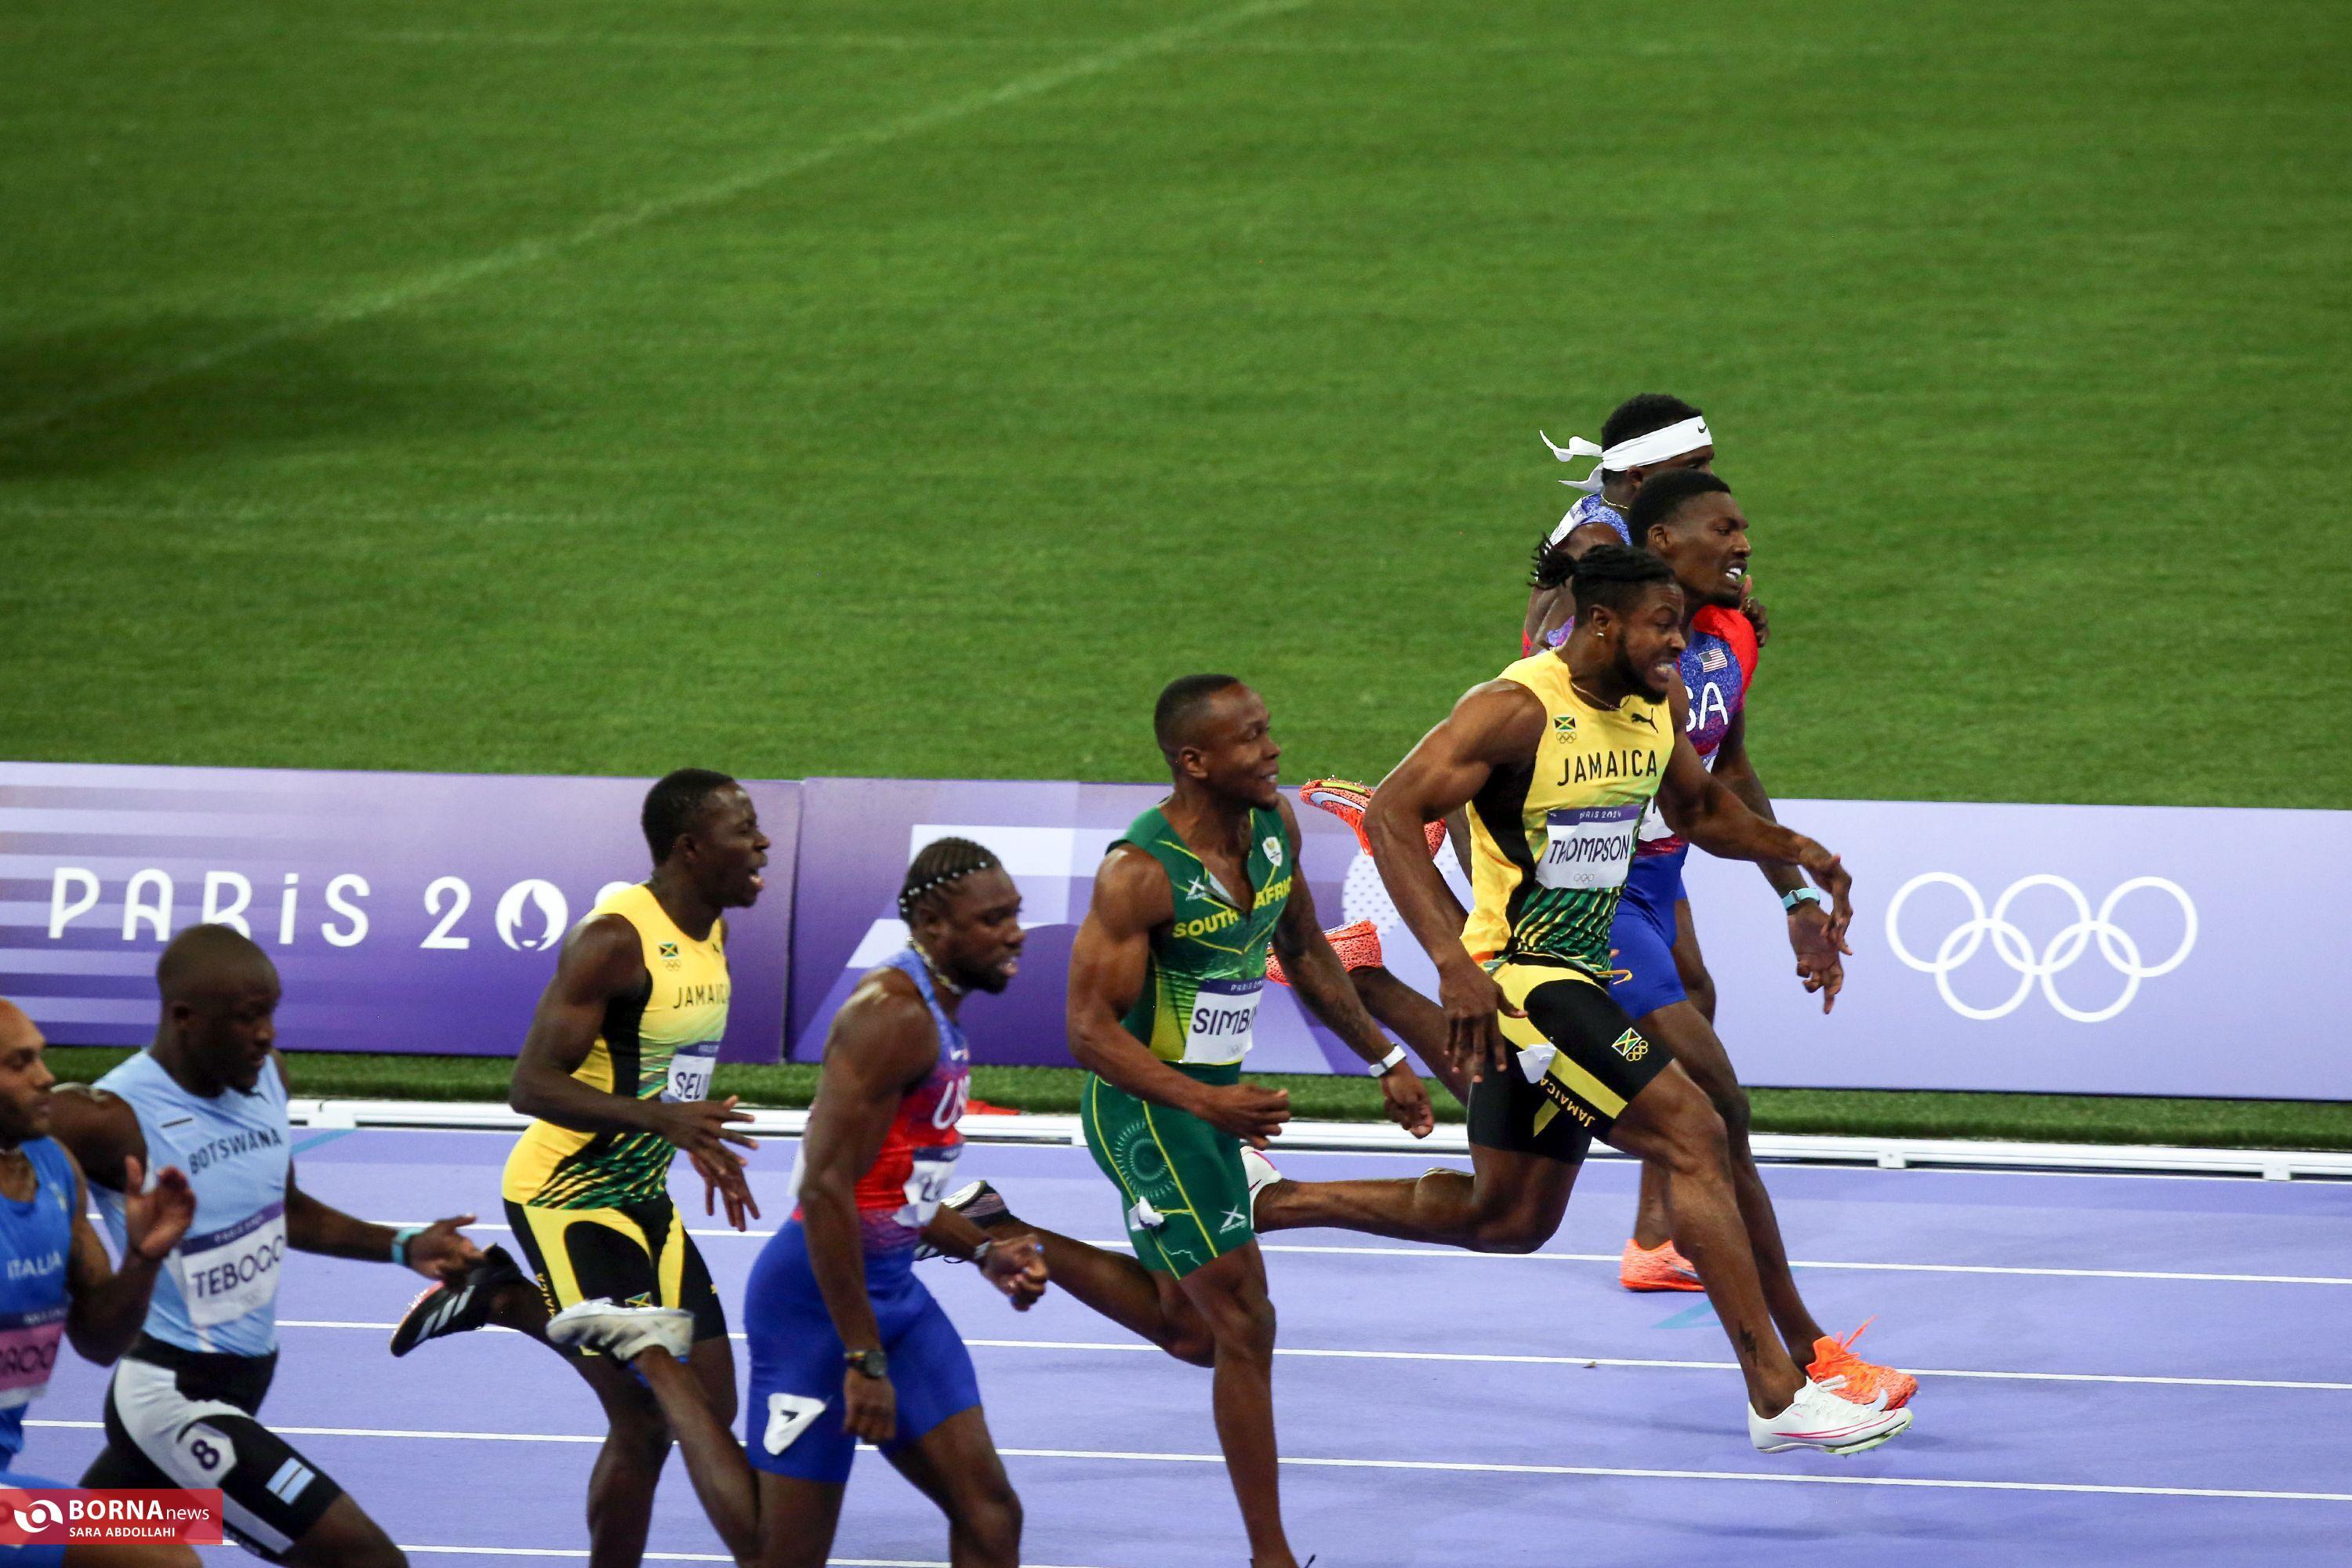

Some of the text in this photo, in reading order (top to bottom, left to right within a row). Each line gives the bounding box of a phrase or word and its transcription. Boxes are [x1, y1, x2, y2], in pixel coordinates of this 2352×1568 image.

[1685, 681, 1728, 731] SA
[1557, 750, 1657, 786] JAMAICA
[1548, 834, 1631, 865] THOMPSON
[1173, 908, 1240, 938] SOUTH
[1540, 1078, 1595, 1127] JAMAICA
[188, 1127, 284, 1175] BOTSWANA
[191, 1439, 220, 1471] 8
